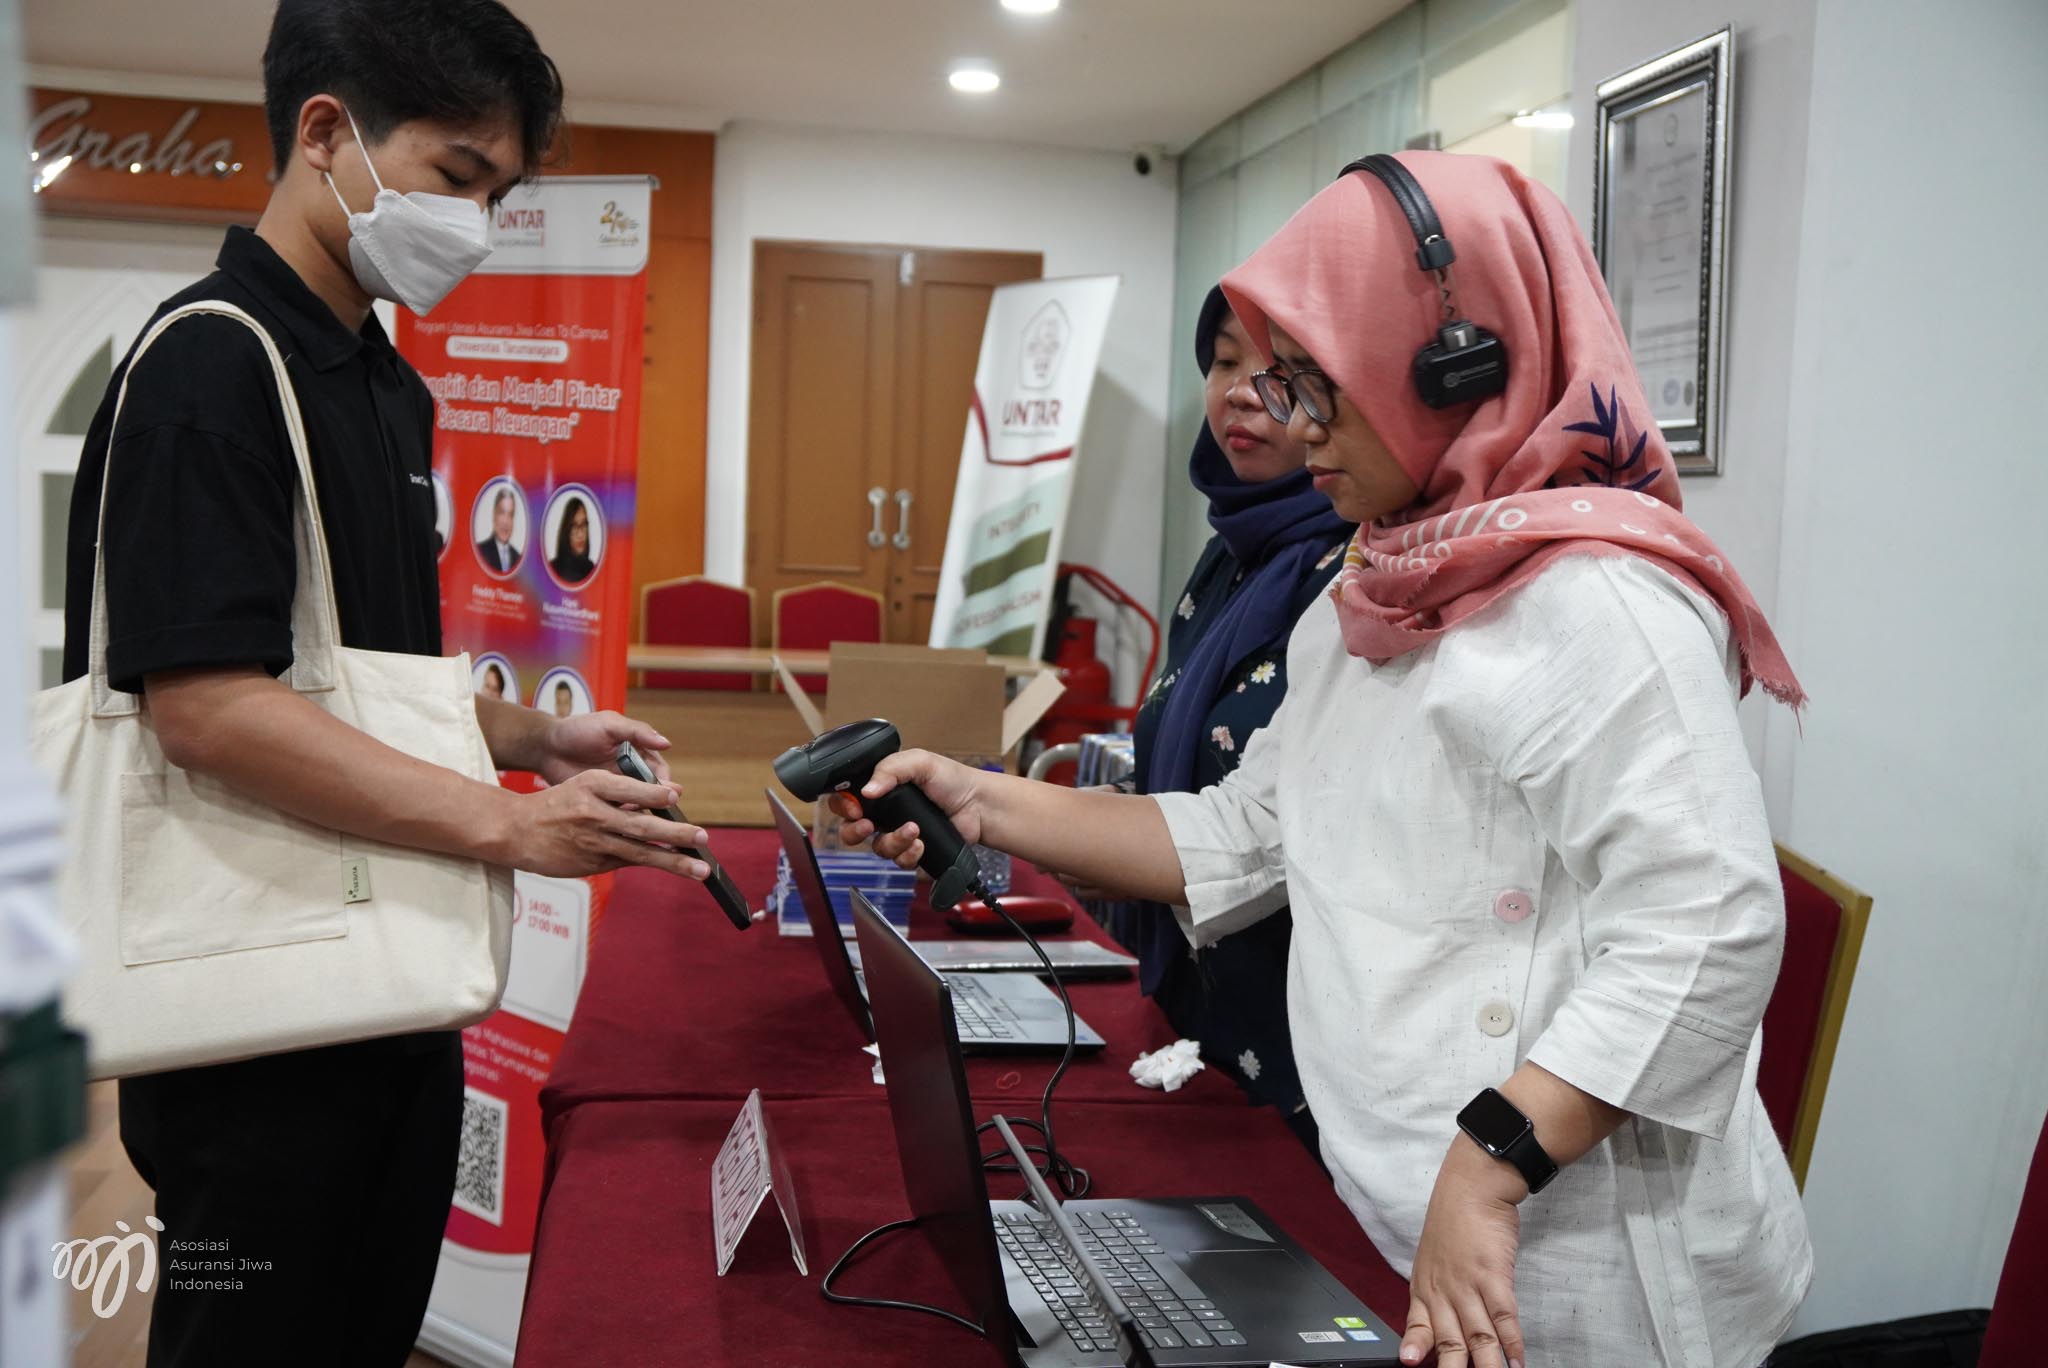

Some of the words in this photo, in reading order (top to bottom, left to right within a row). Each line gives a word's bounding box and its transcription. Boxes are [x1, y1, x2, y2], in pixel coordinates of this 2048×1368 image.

[497, 210, 544, 229] UNTAR
[570, 325, 608, 340] Campus
[468, 374, 500, 401] dan
[503, 376, 565, 410] Menjadi
[566, 379, 621, 411] Pintar
[1002, 399, 1062, 426] UNTAR
